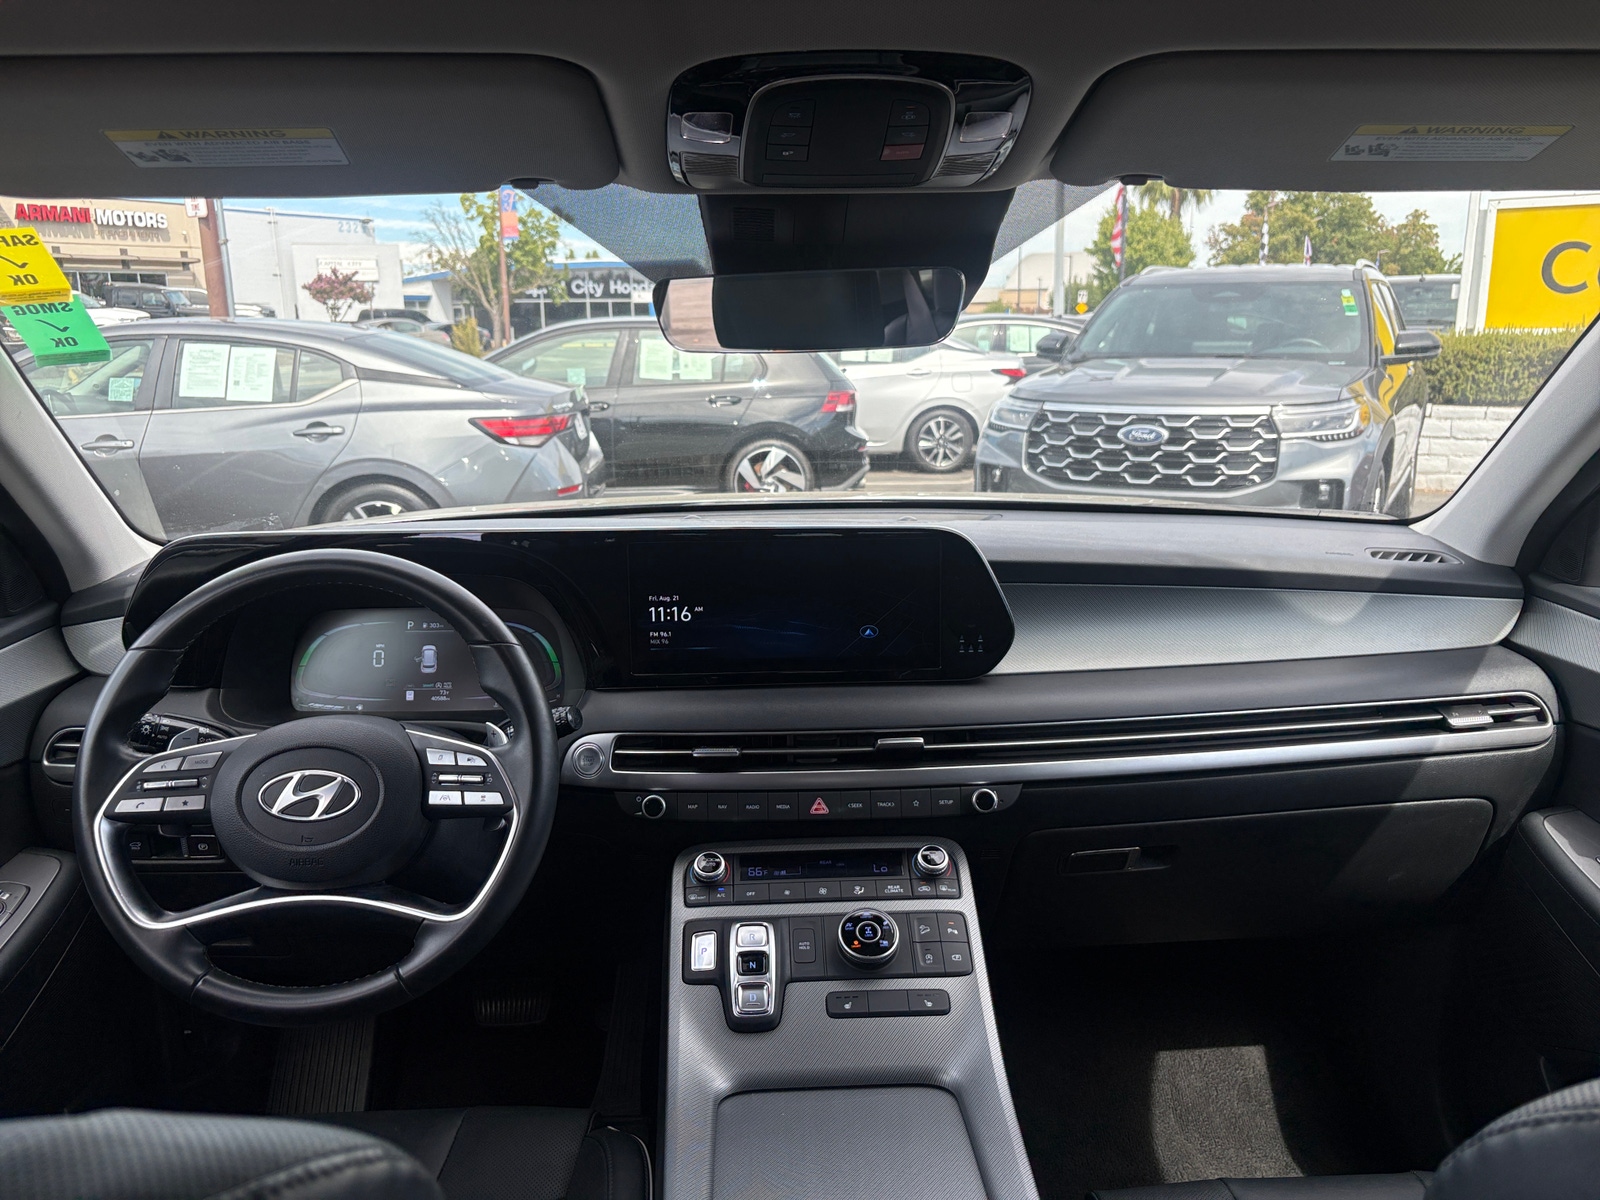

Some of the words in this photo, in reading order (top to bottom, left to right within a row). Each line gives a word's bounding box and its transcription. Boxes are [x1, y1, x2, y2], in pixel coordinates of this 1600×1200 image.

[178, 130, 287, 139] WARNING
[1426, 126, 1526, 135] WARNING
[16, 203, 92, 224] ARMANI
[95, 208, 168, 229] MOTORS
[570, 279, 605, 298] City
[649, 606, 692, 622] 11:16
[407, 620, 415, 630] P
[373, 650, 385, 668] 0
[749, 933, 755, 941] R
[701, 947, 708, 956] P
[749, 961, 756, 969] N
[749, 993, 757, 1001] D
